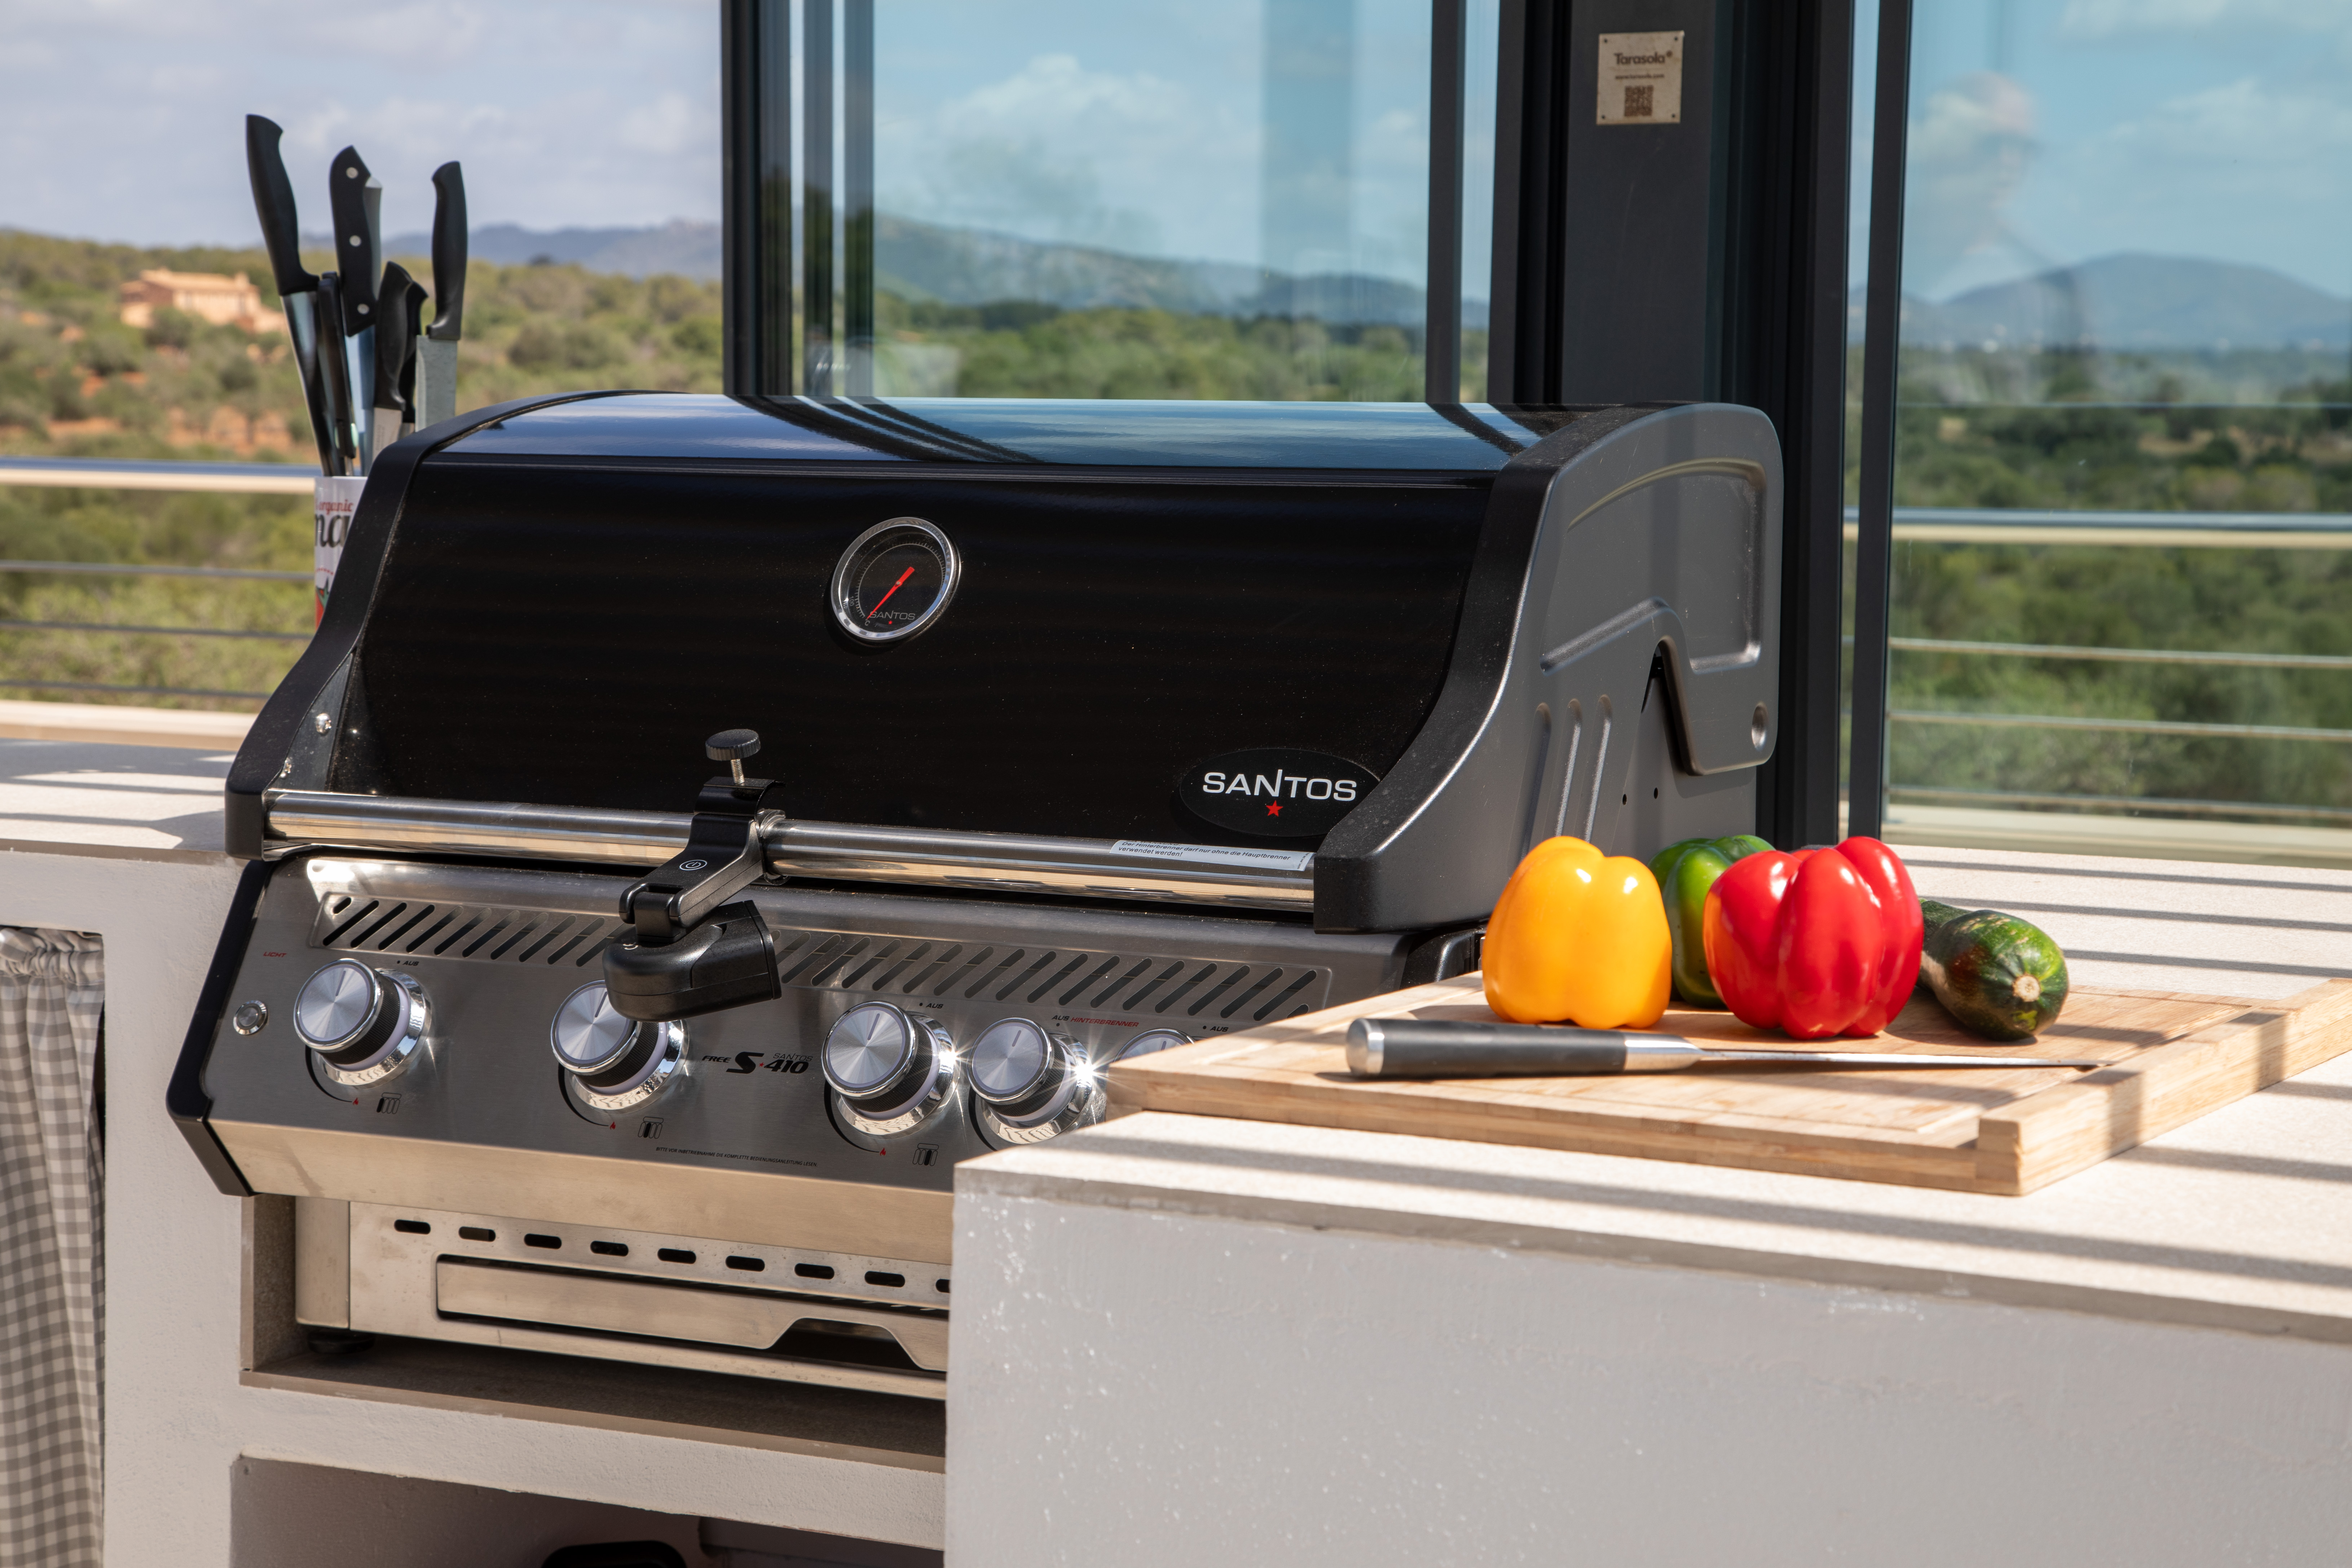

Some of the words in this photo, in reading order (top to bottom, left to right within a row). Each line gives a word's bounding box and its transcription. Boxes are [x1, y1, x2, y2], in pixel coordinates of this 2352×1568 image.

[869, 610, 915, 620] SANTOS
[1203, 769, 1357, 801] SANTOS
[1242, 852, 1291, 860] Hauptbrenner
[1070, 1017, 1139, 1027] HINTERBRENNER
[773, 1053, 813, 1062] SANTOS
[750, 1156, 802, 1166] BEDIENUNGSANLEITUNG
